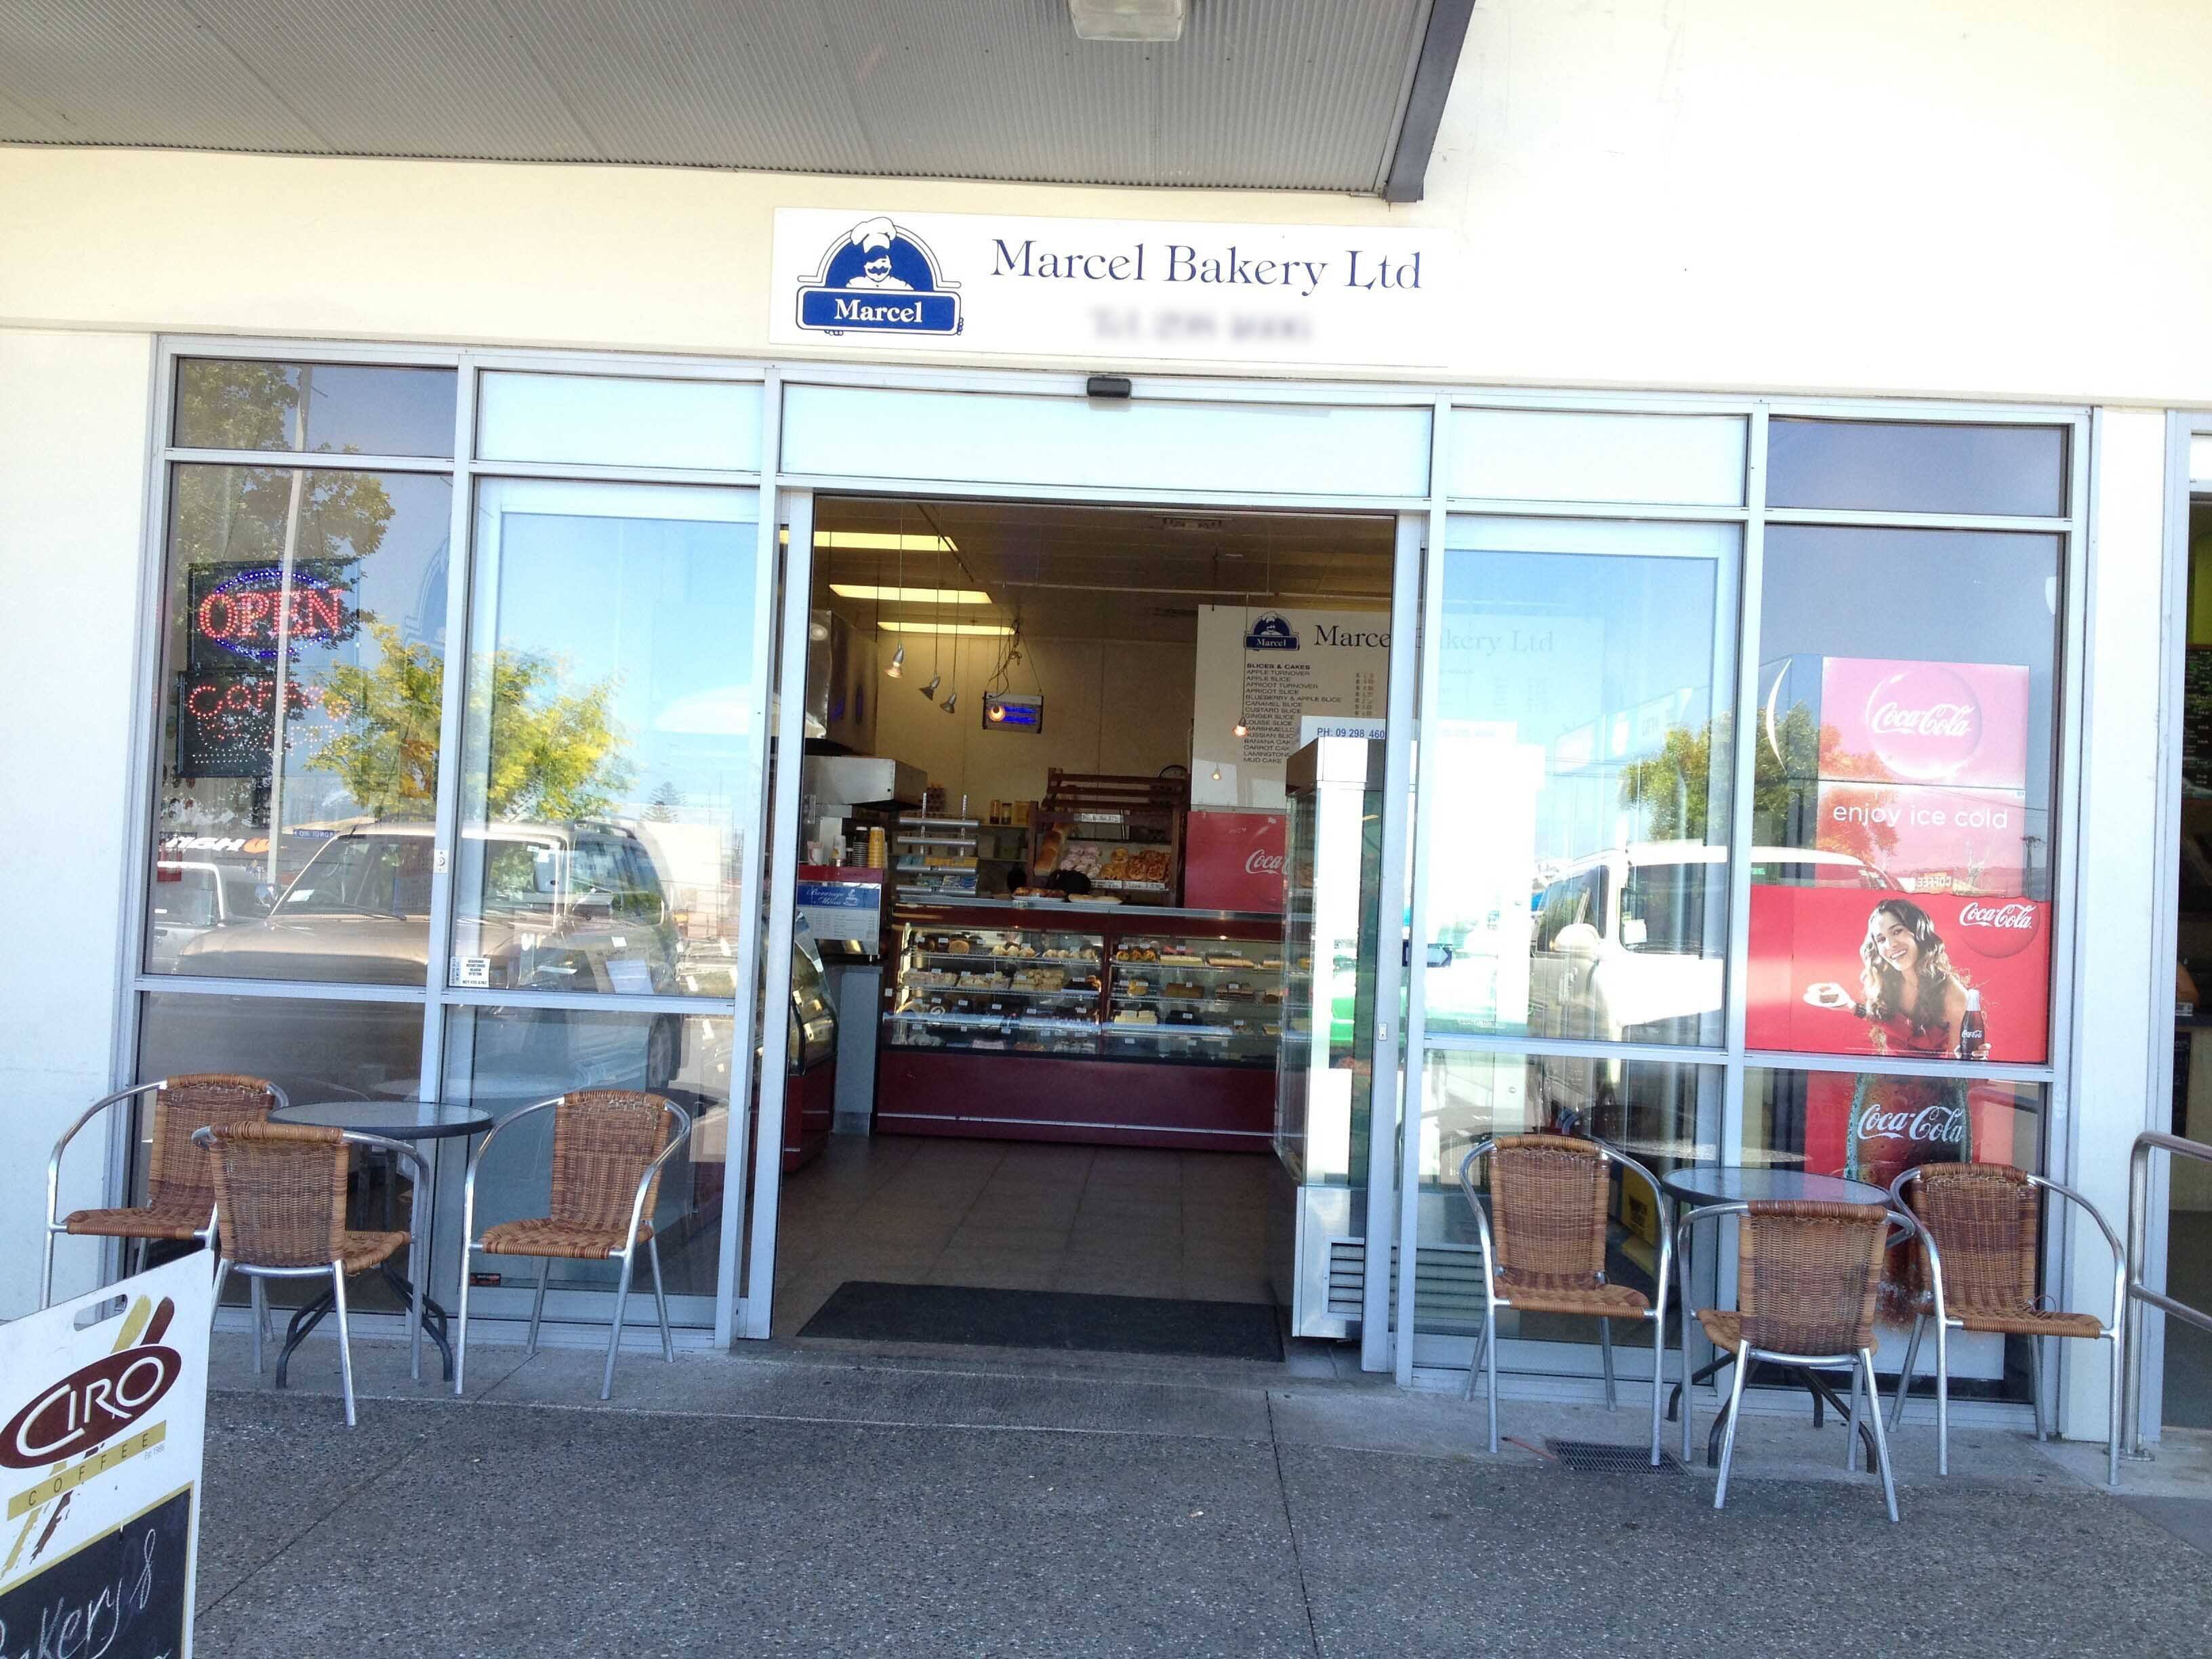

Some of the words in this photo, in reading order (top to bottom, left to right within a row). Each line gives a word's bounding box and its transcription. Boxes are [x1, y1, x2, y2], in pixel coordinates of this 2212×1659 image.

[991, 239, 1146, 282] Marcel
[1164, 245, 1330, 296] Bakery
[1344, 249, 1422, 290] Ltd
[834, 298, 922, 324] Marcel
[199, 588, 344, 639] OPEN
[1256, 638, 1286, 647] Marcel
[1313, 624, 1391, 648] Marce
[1317, 727, 1333, 737] PH:
[1335, 728, 1347, 737] 09
[1349, 729, 1365, 738] 298
[1369, 729, 1385, 739] 460
[1872, 702, 1975, 737] Coca-Cola
[1832, 805, 1900, 828] enjoy
[1910, 807, 1946, 824] ice
[1954, 809, 2008, 829] cold
[1959, 902, 2036, 929] Coca-Cola
[1857, 1104, 1965, 1143] Coca-Cola
[16, 1356, 165, 1457] CIRO
[28, 1432, 150, 1507] COFFEE
